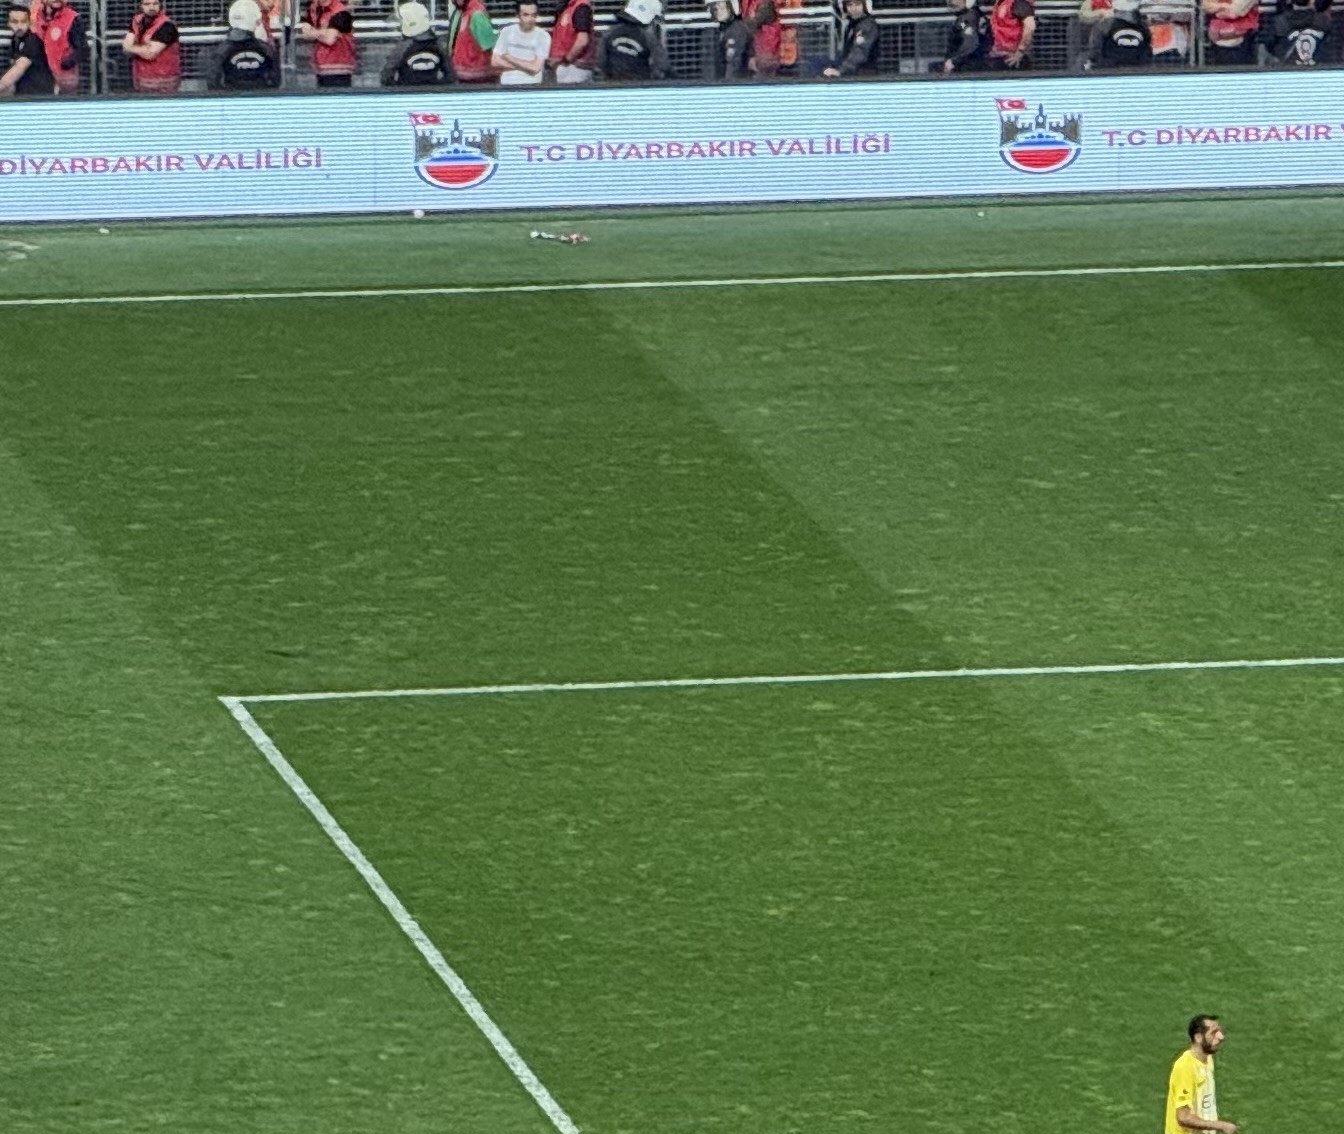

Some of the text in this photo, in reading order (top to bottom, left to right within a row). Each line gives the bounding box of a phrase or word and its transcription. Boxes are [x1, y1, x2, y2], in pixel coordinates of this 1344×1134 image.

[520, 133, 891, 162] T.C DİYARBAKIR VALİLİĞİ
[1102, 129, 1147, 147] T.C
[1156, 124, 1333, 145] DİYARBAKIR
[0, 148, 322, 175] DİYARBAKIR VALİLİĞİ
